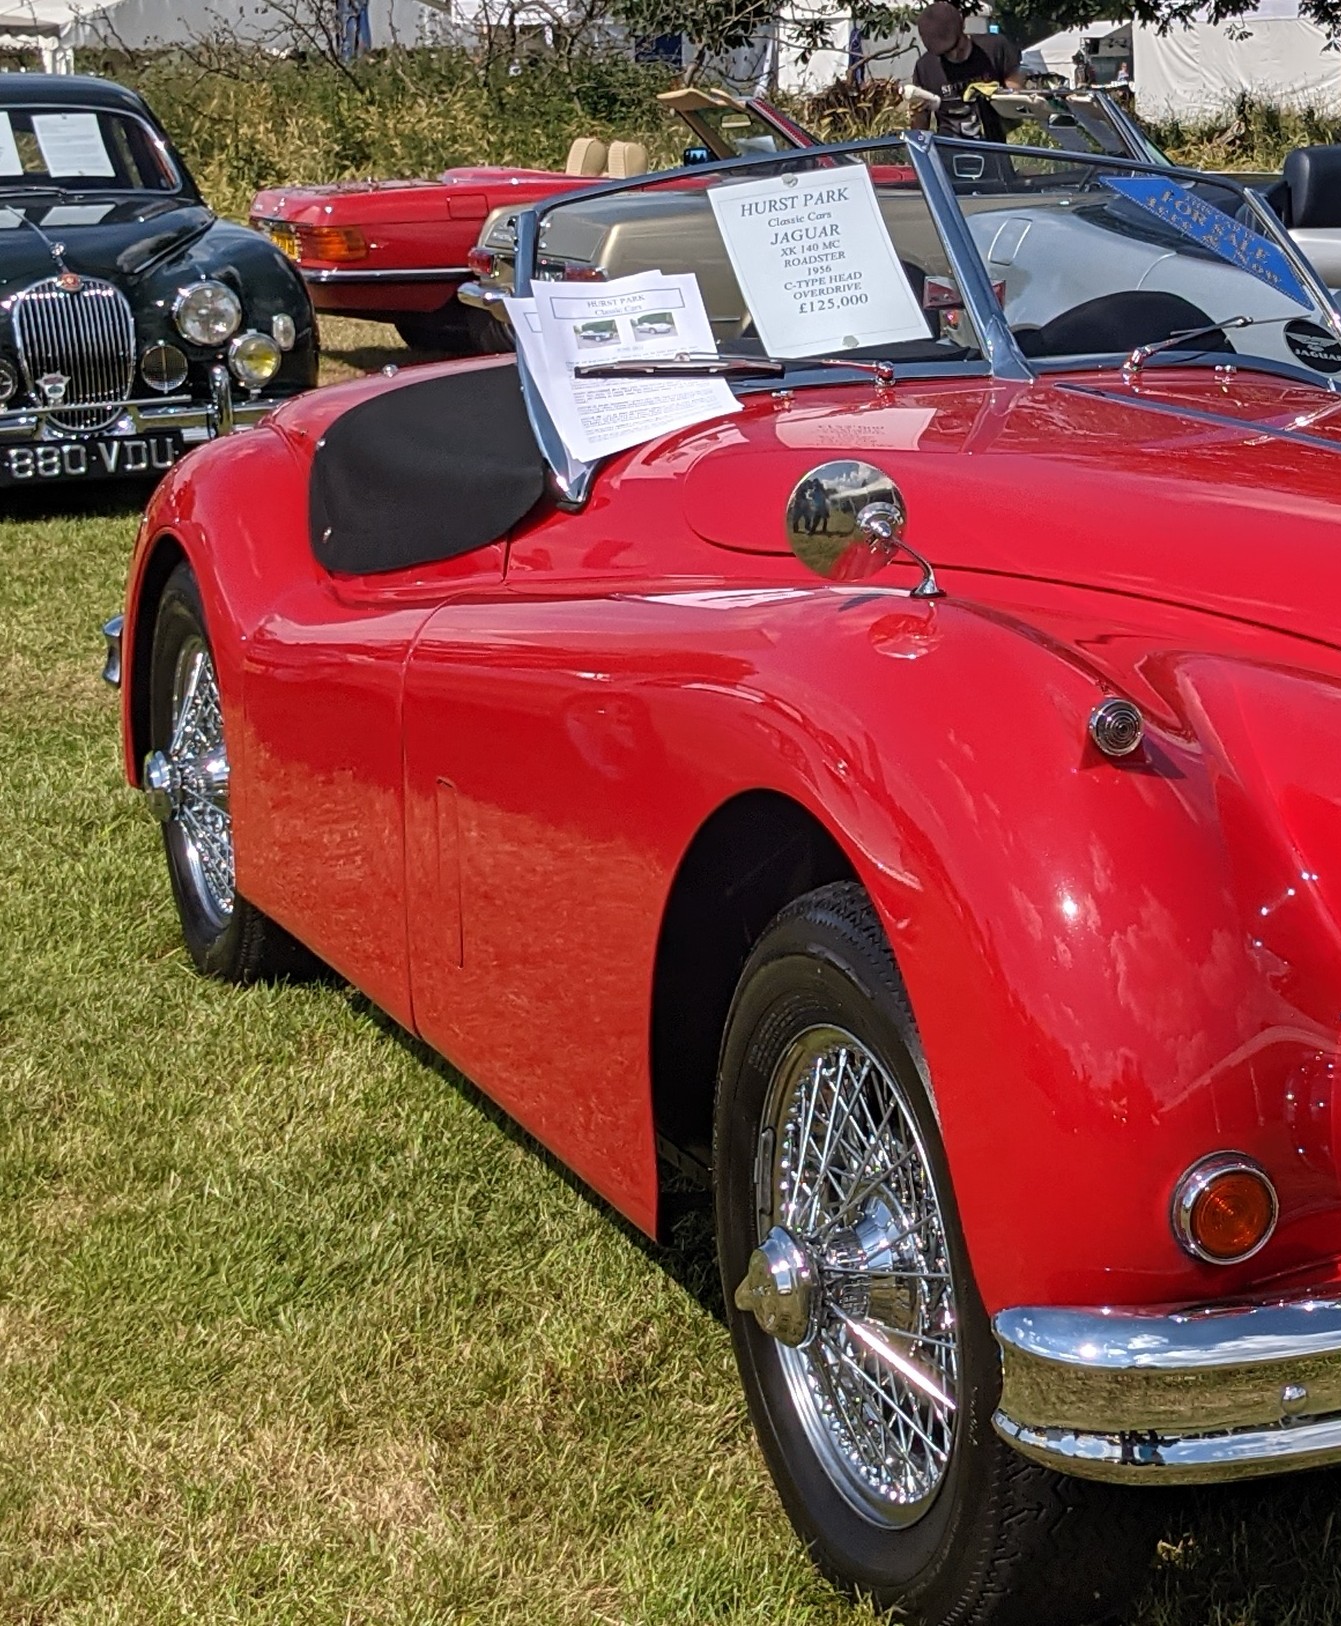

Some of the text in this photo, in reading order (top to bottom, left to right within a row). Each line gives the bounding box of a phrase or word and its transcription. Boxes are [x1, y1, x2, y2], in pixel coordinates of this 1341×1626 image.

[740, 187, 849, 217] HURST PARK
[1161, 190, 1207, 227] FOR
[767, 211, 832, 227] Classic Cars
[769, 223, 841, 246] JAGUAR
[780, 240, 841, 257] XK 140 MC
[783, 251, 846, 268] ROADSTER
[807, 264, 832, 276] 1956
[783, 271, 863, 291] C-TYPE HEAD
[793, 281, 862, 300] OVERDRIVE
[587, 294, 646, 309] HURST PARK
[798, 293, 869, 314] £125,000
[8, 437, 174, 478] 880 VDU
